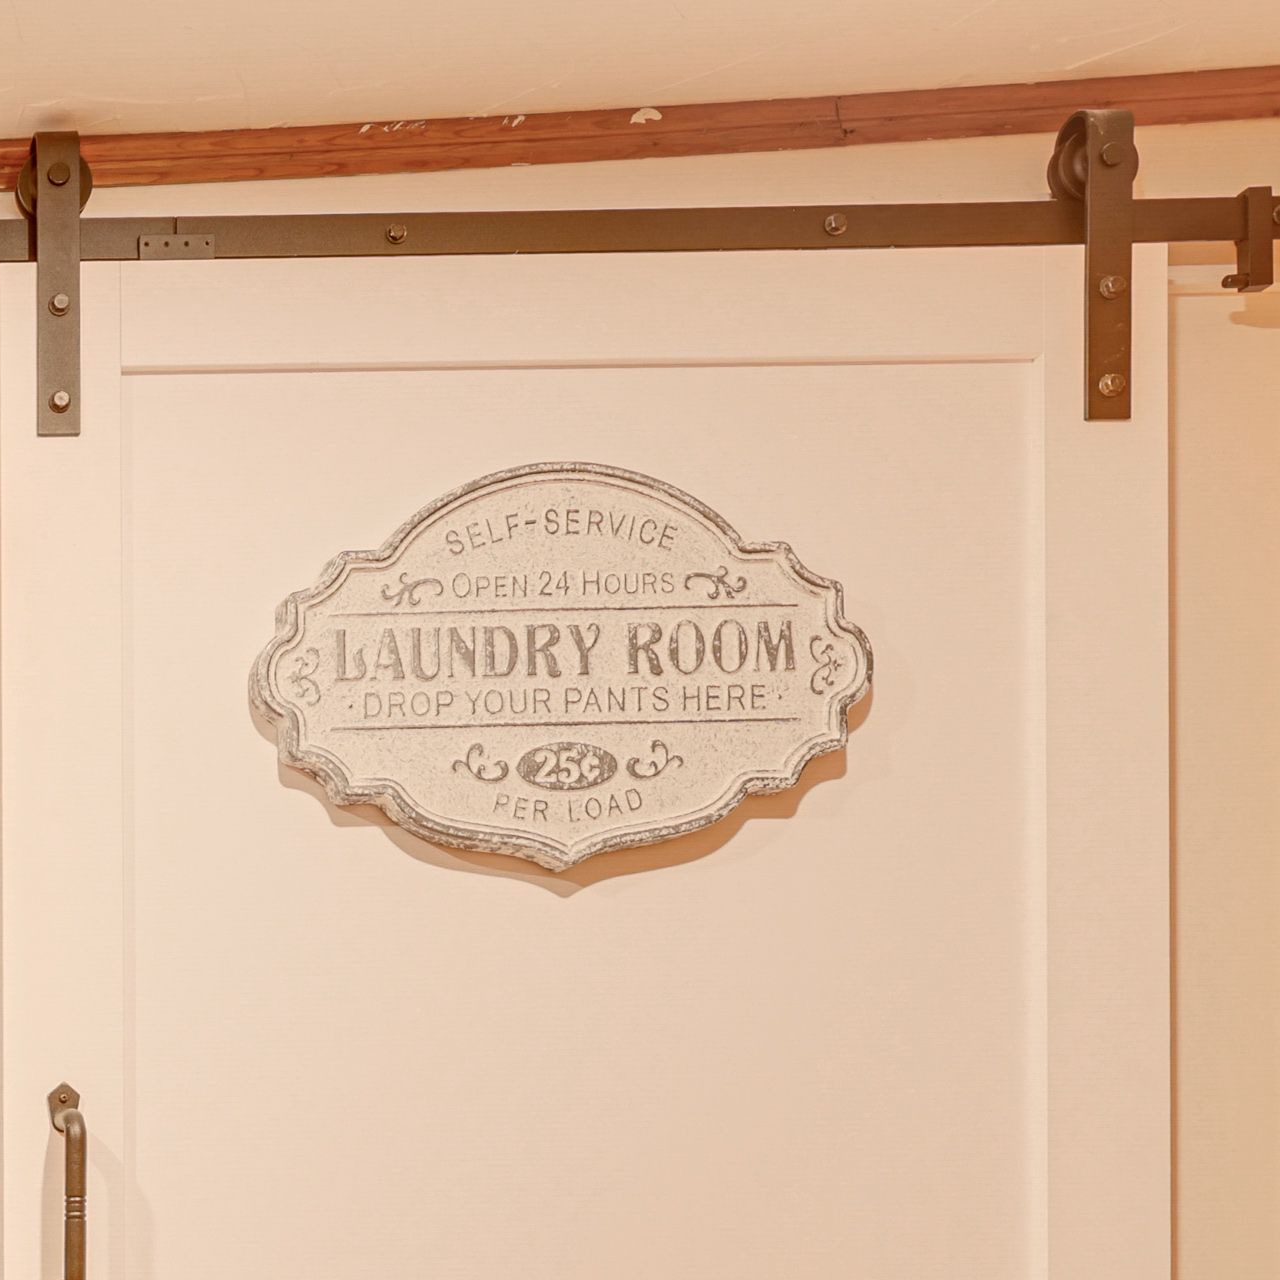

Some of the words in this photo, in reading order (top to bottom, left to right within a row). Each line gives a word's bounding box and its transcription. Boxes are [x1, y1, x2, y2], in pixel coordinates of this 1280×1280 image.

[446, 509, 679, 556] SELF-SERVICE
[451, 572, 529, 599] OPEN
[537, 571, 571, 596] 24
[581, 570, 676, 596] HOURS
[333, 623, 599, 683] LAUNDRY
[627, 620, 798, 677] ROOM
[363, 690, 454, 719] DROP
[468, 689, 551, 717] YOUR
[564, 687, 670, 714] PANTS
[682, 684, 767, 712] HERE
[534, 746, 602, 786] 25¢
[492, 793, 549, 823] PER
[567, 788, 644, 822] LOAD
